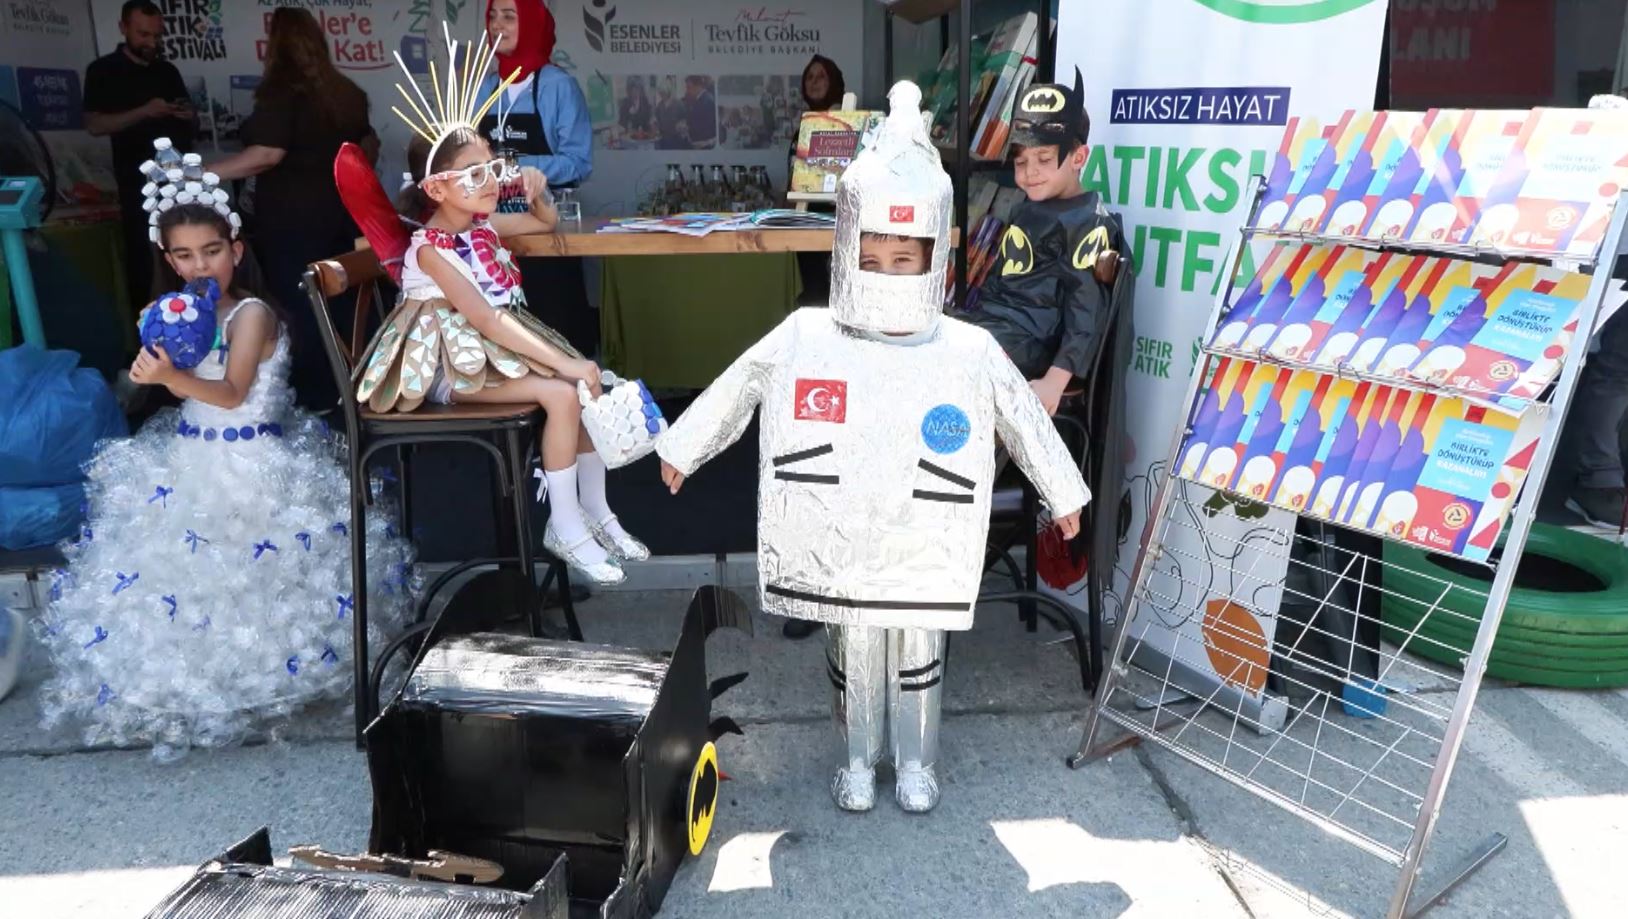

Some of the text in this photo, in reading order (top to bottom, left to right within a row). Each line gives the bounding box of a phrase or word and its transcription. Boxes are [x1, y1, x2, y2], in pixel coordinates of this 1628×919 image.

[610, 24, 680, 39] ESENLER
[705, 23, 820, 42] Tevfik Göksu
[335, 41, 384, 62] Kat!
[610, 40, 681, 53] BELEDİYESİ
[708, 45, 763, 54] BELEDİYE
[1390, 26, 1471, 60] LANI
[1114, 95, 1281, 121] ATIKSIZ HAYAT
[1080, 144, 1267, 214] ATIKSI
[1136, 336, 1173, 359] SIFIR
[1134, 354, 1171, 379] ATIK
[926, 420, 970, 438] NASA
